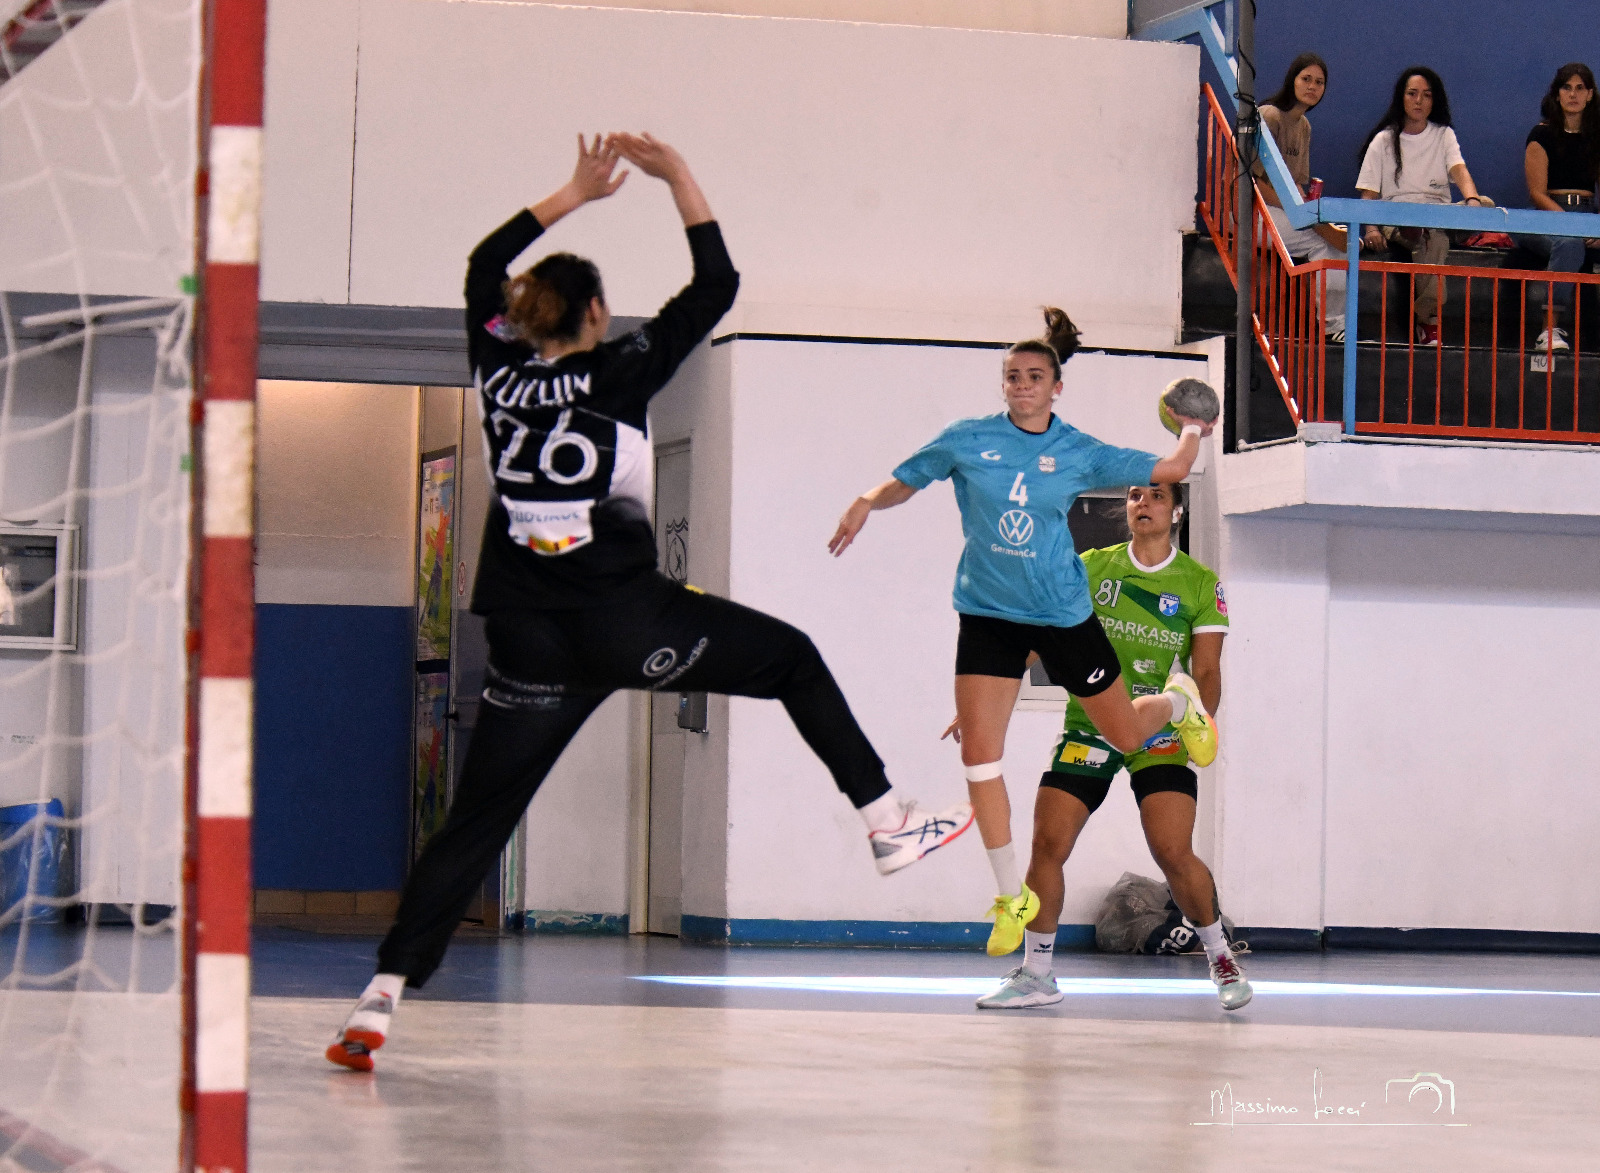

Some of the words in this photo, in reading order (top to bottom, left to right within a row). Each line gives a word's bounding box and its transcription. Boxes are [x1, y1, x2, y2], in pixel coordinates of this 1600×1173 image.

[489, 407, 599, 486] 26
[1008, 471, 1028, 507] 4
[990, 542, 1037, 559] GermanCar
[1094, 578, 1122, 608] 81
[1097, 615, 1186, 646] SPARKASSE
[1138, 637, 1182, 652] RISPARMIO
